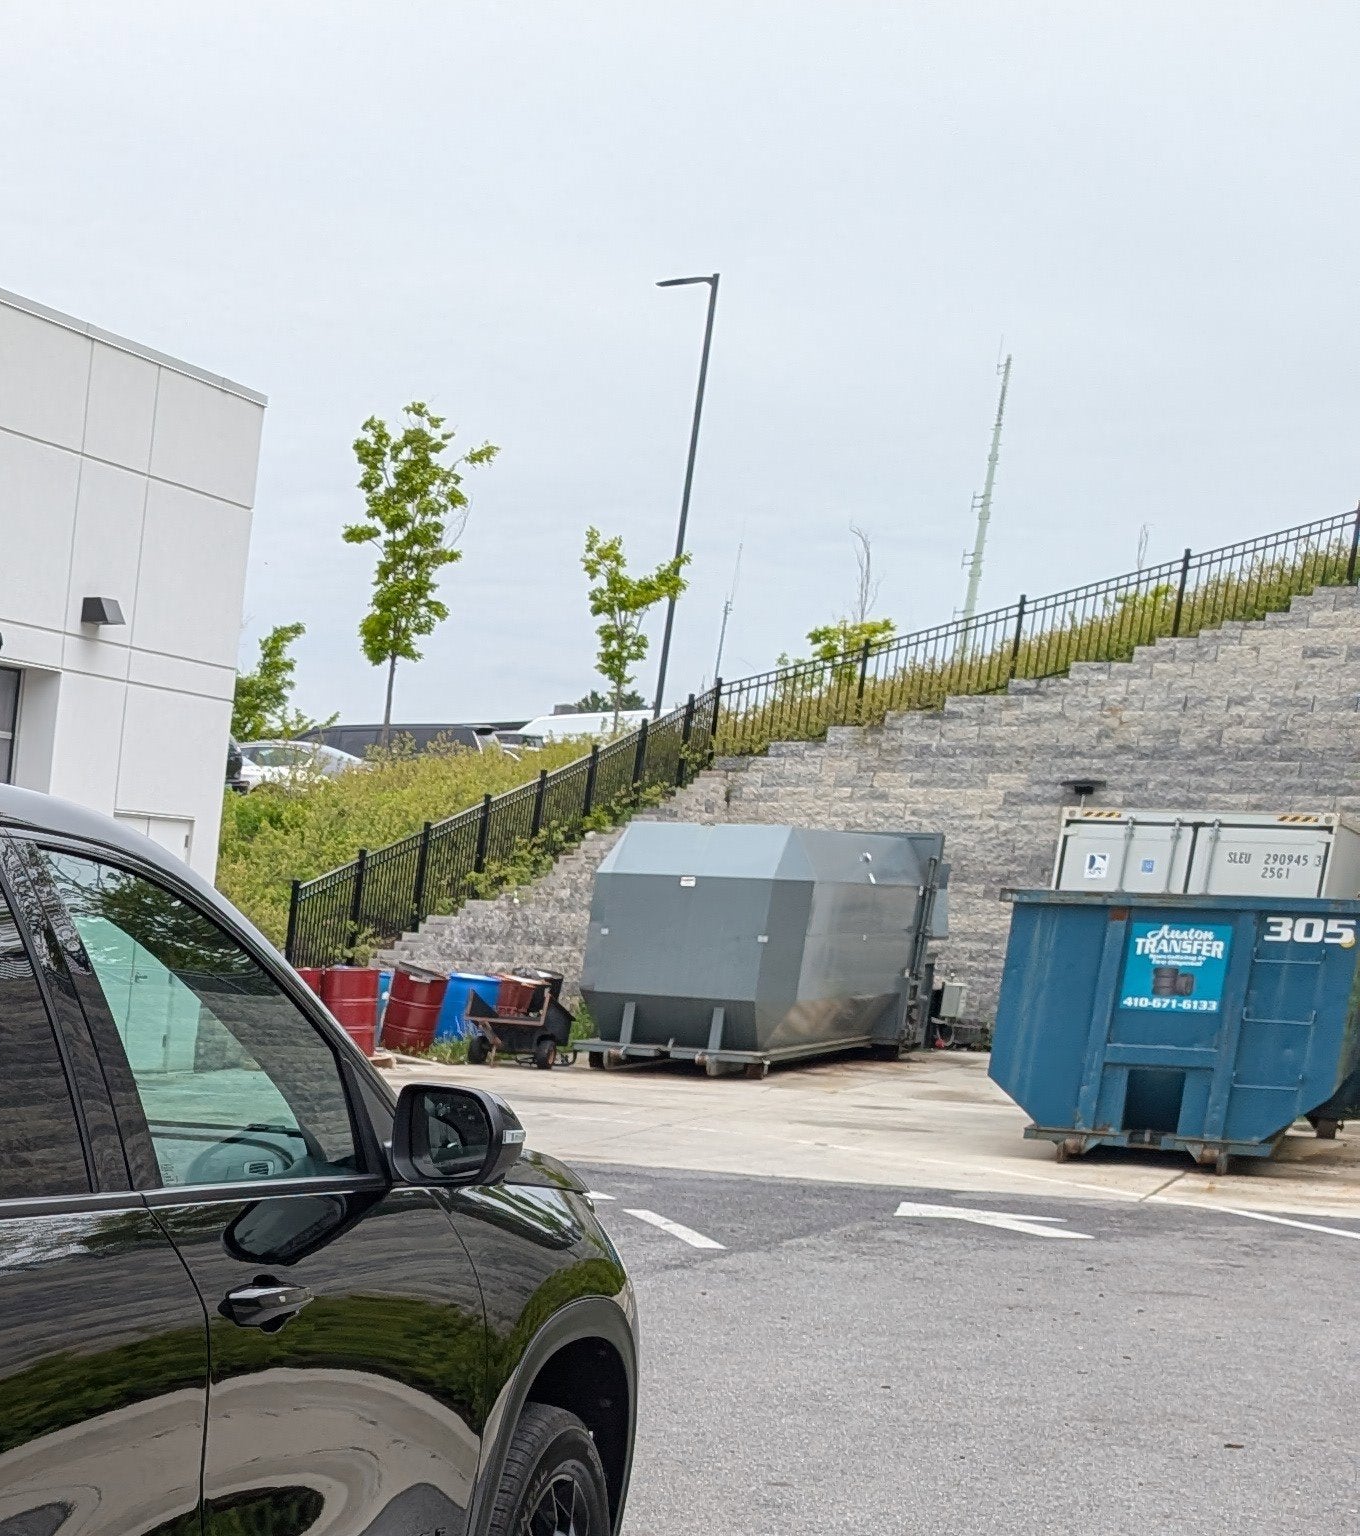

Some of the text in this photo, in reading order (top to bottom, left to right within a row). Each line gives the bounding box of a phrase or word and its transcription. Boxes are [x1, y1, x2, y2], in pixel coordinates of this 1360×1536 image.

[1227, 852, 1252, 865] SLEU
[1264, 853, 1309, 867] 290945
[1263, 916, 1357, 944] 305
[1135, 937, 1224, 960] TRANSFER
[1123, 997, 1218, 1011] 410-671-6133
